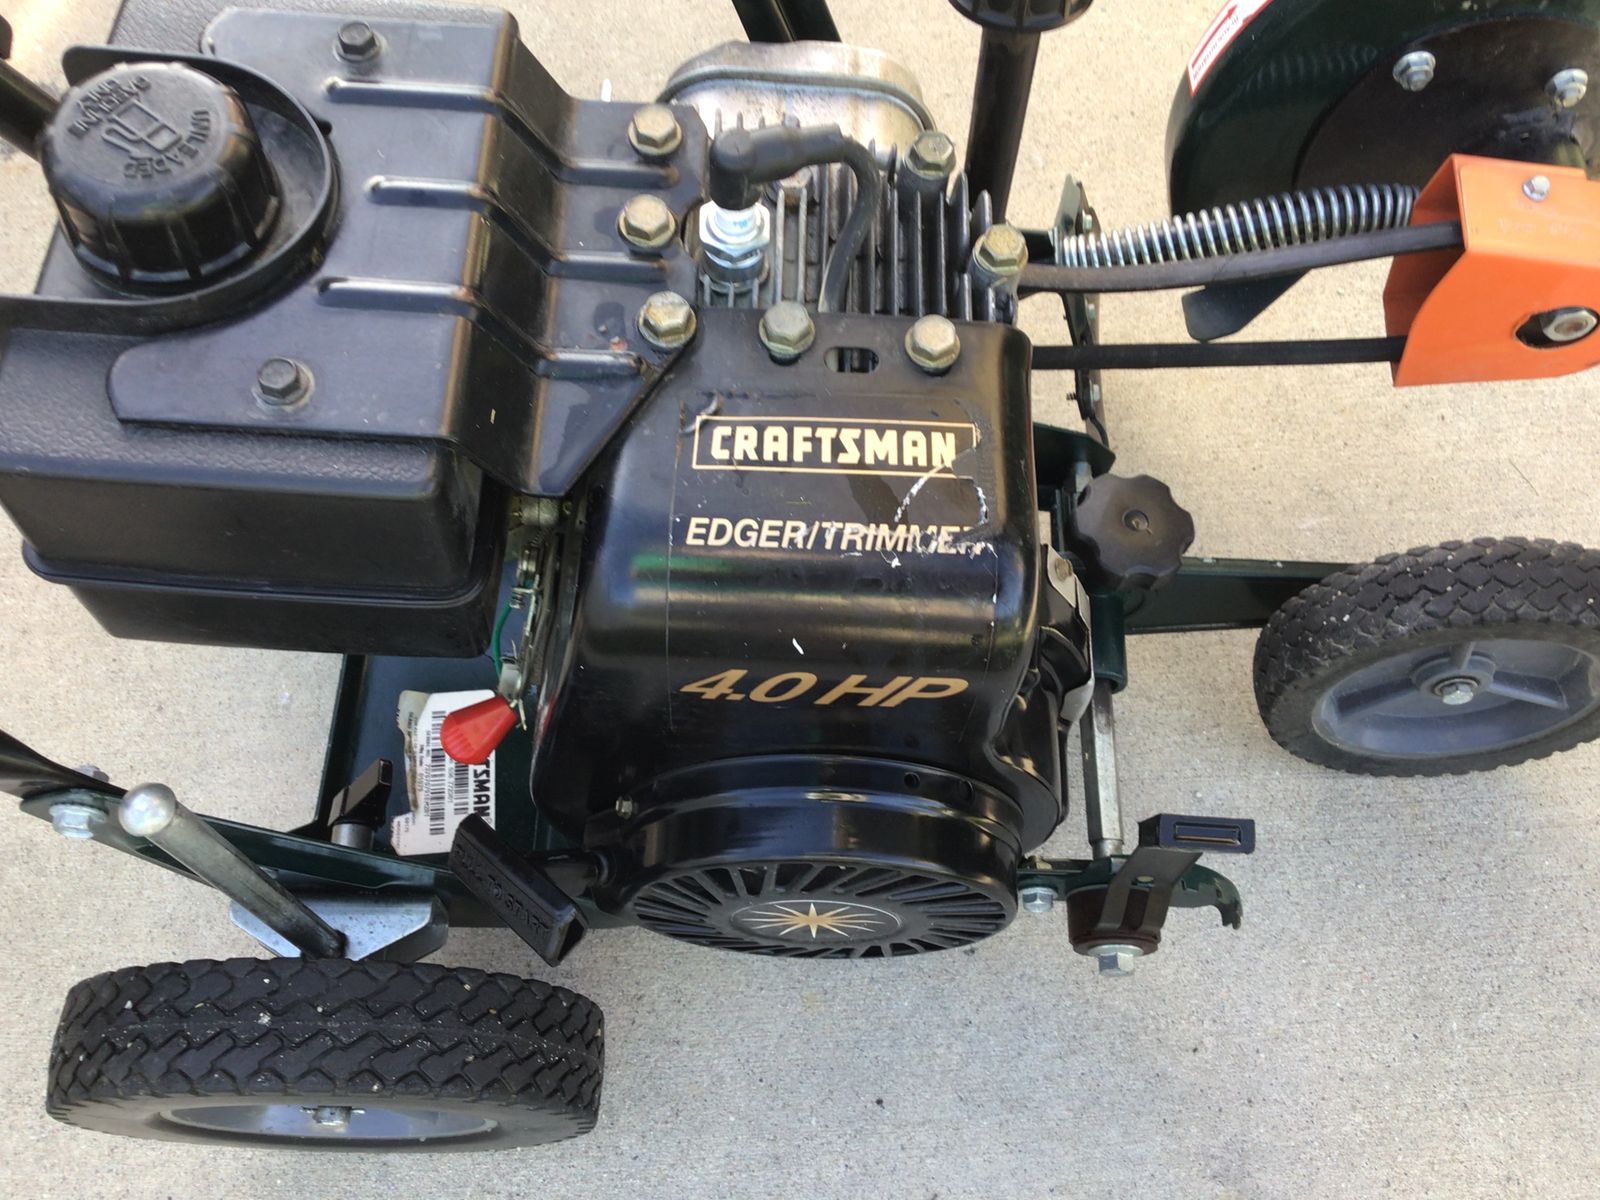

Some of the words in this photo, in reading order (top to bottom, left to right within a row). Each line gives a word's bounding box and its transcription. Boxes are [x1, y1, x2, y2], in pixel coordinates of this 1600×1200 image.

[67, 76, 151, 139] GASOLINE
[123, 109, 211, 179] UNLEADED
[709, 424, 957, 468] CRAFTSMAN
[679, 668, 818, 703] 4.0
[813, 673, 969, 708] HP
[504, 894, 550, 938] START
